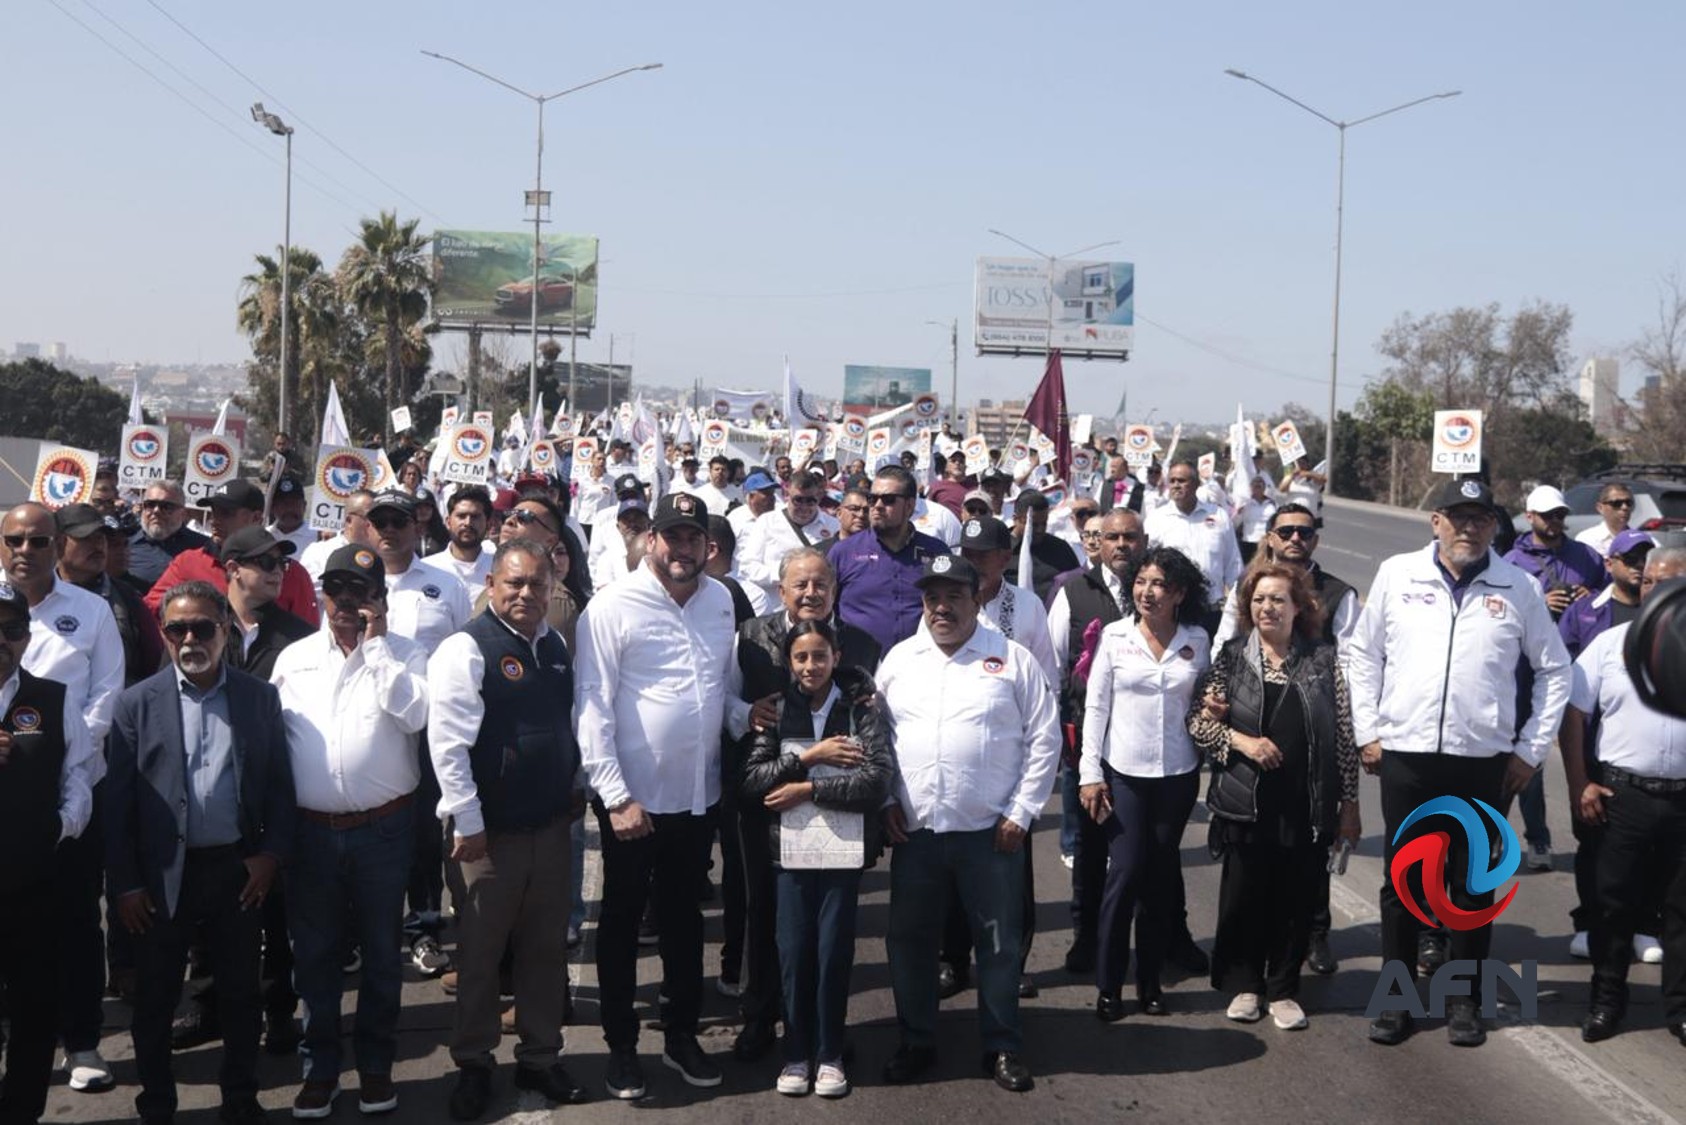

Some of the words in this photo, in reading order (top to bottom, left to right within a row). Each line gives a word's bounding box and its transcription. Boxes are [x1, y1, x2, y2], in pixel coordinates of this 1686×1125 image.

[917, 417, 939, 427] CTM
[840, 436, 862, 446] CTM
[702, 446, 723, 454] CTM
[1126, 452, 1149, 460] CTM
[1437, 452, 1476, 463] CTM
[123, 465, 163, 479] CTM
[449, 462, 484, 476] CTM
[188, 481, 215, 497] CT
